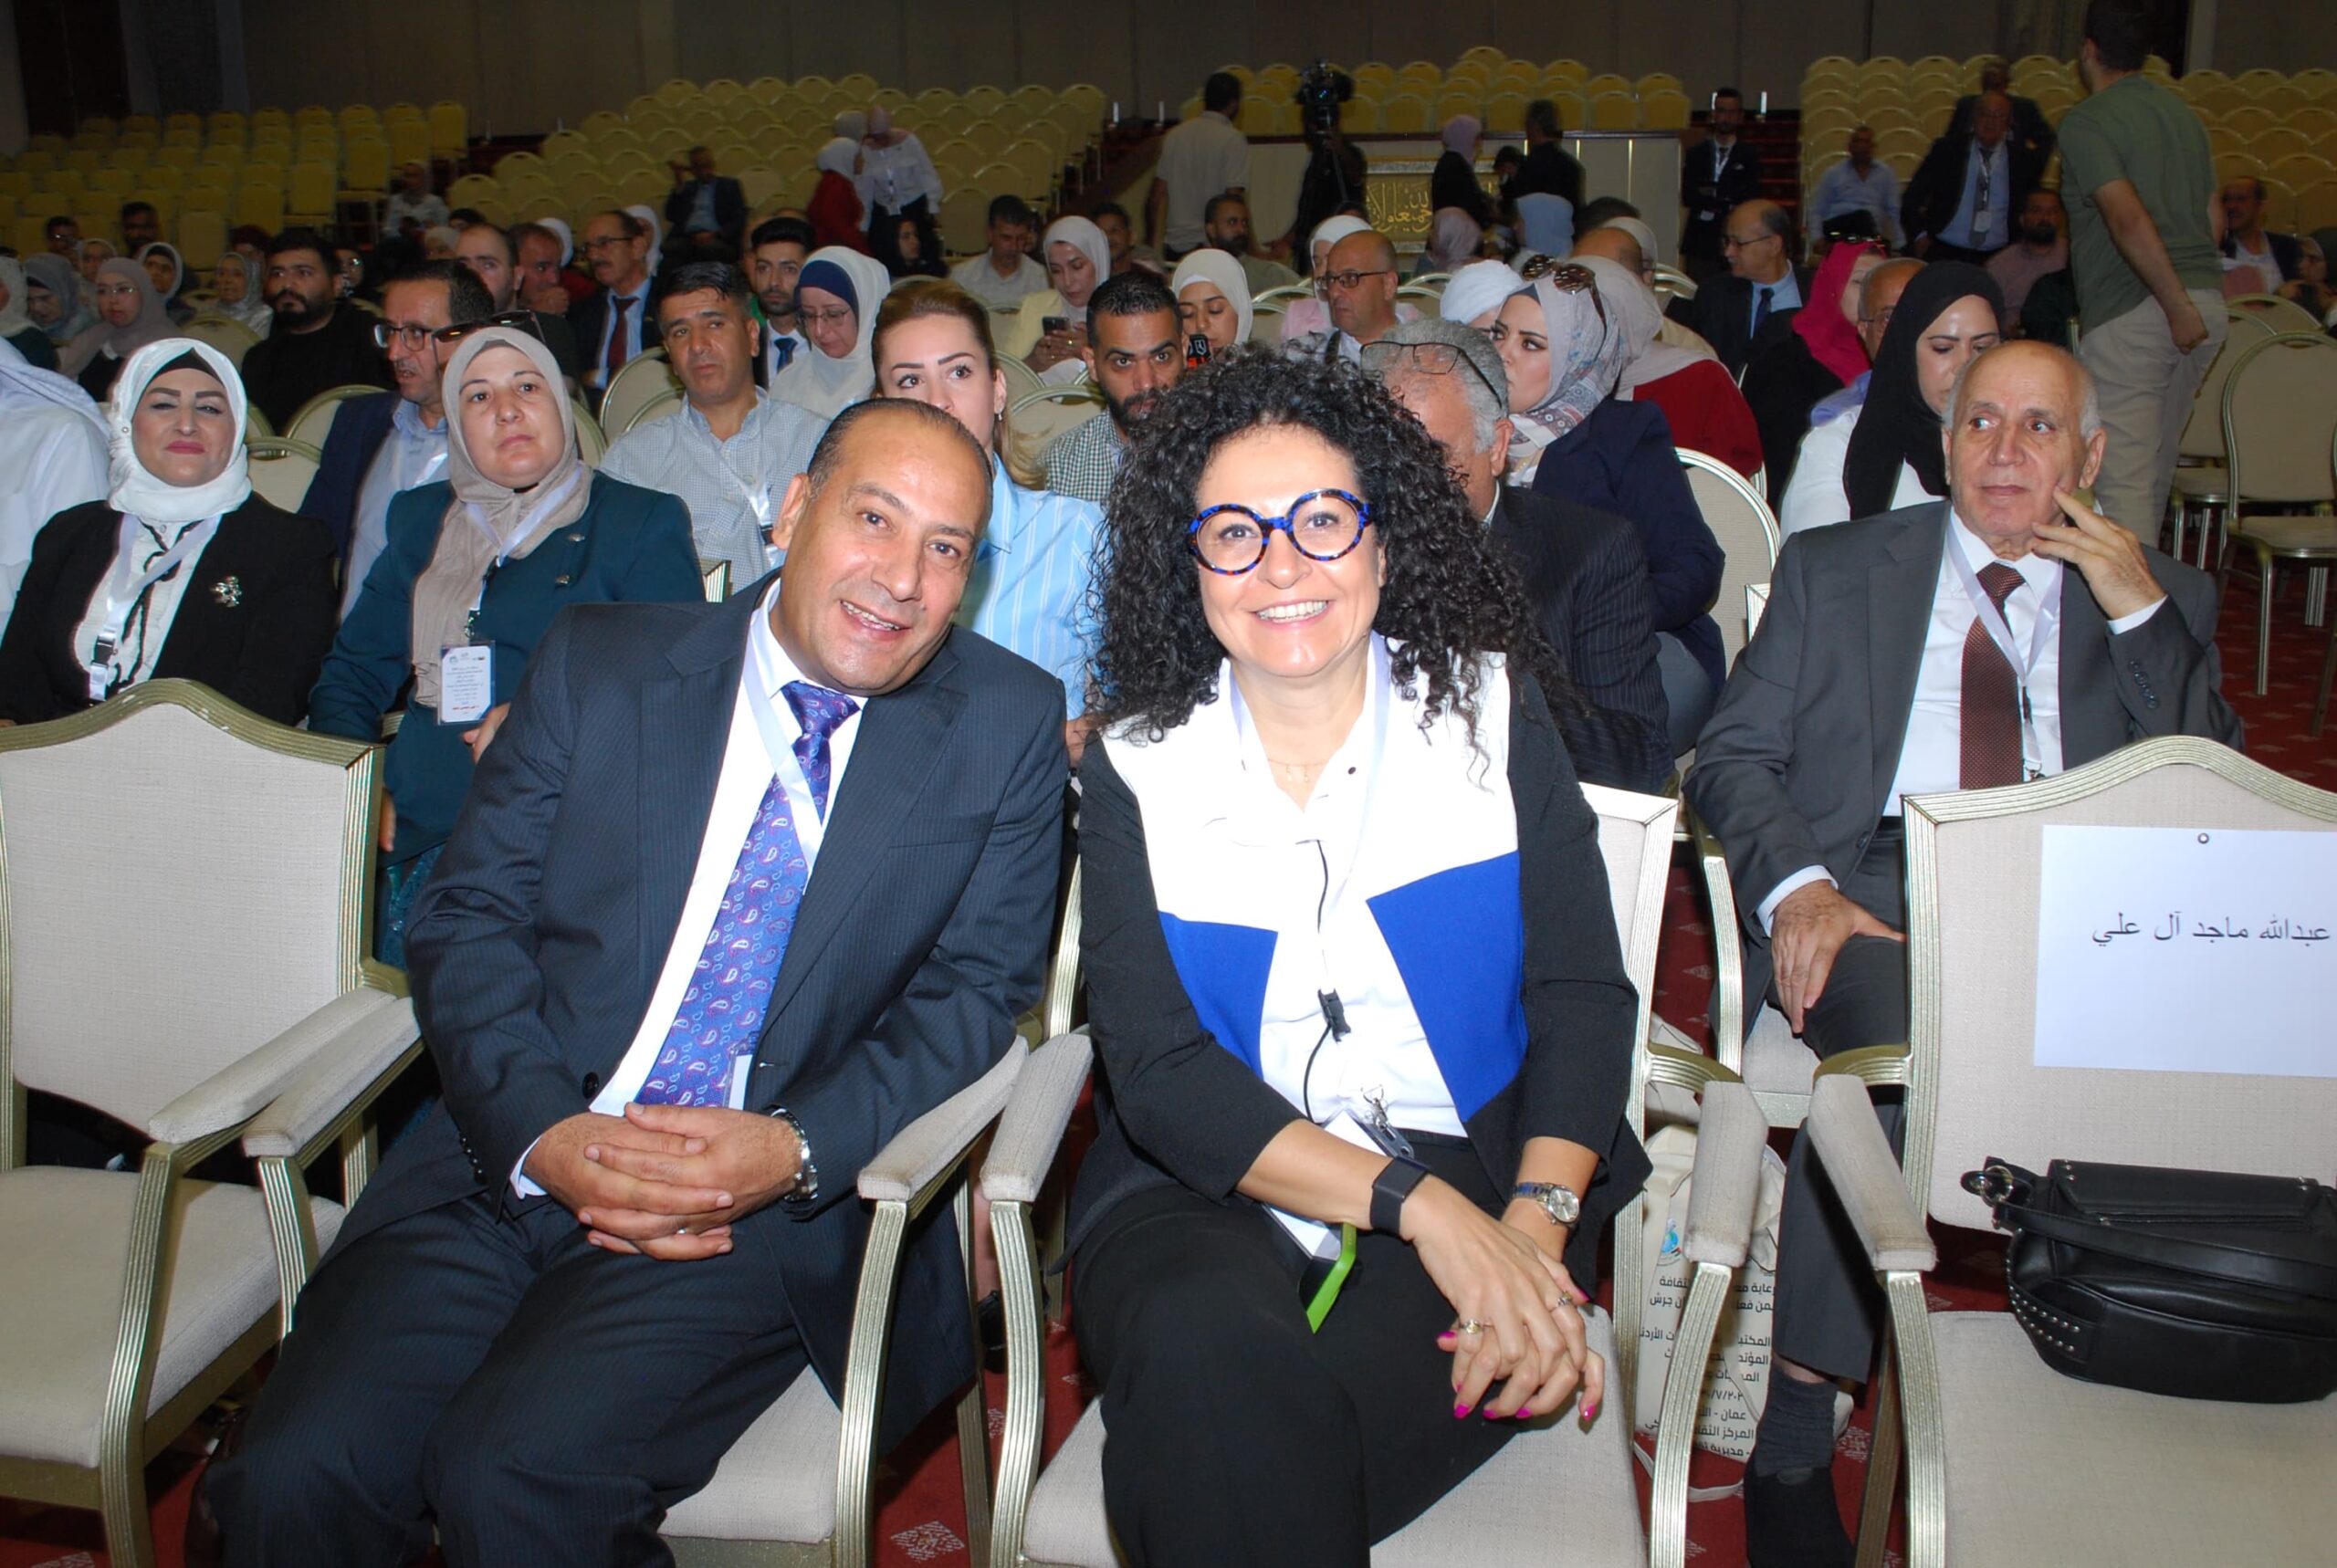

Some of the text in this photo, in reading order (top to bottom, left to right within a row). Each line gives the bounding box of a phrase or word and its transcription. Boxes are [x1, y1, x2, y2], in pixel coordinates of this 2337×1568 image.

[2092, 911, 2331, 946] عبدالله ماجد آل علي
